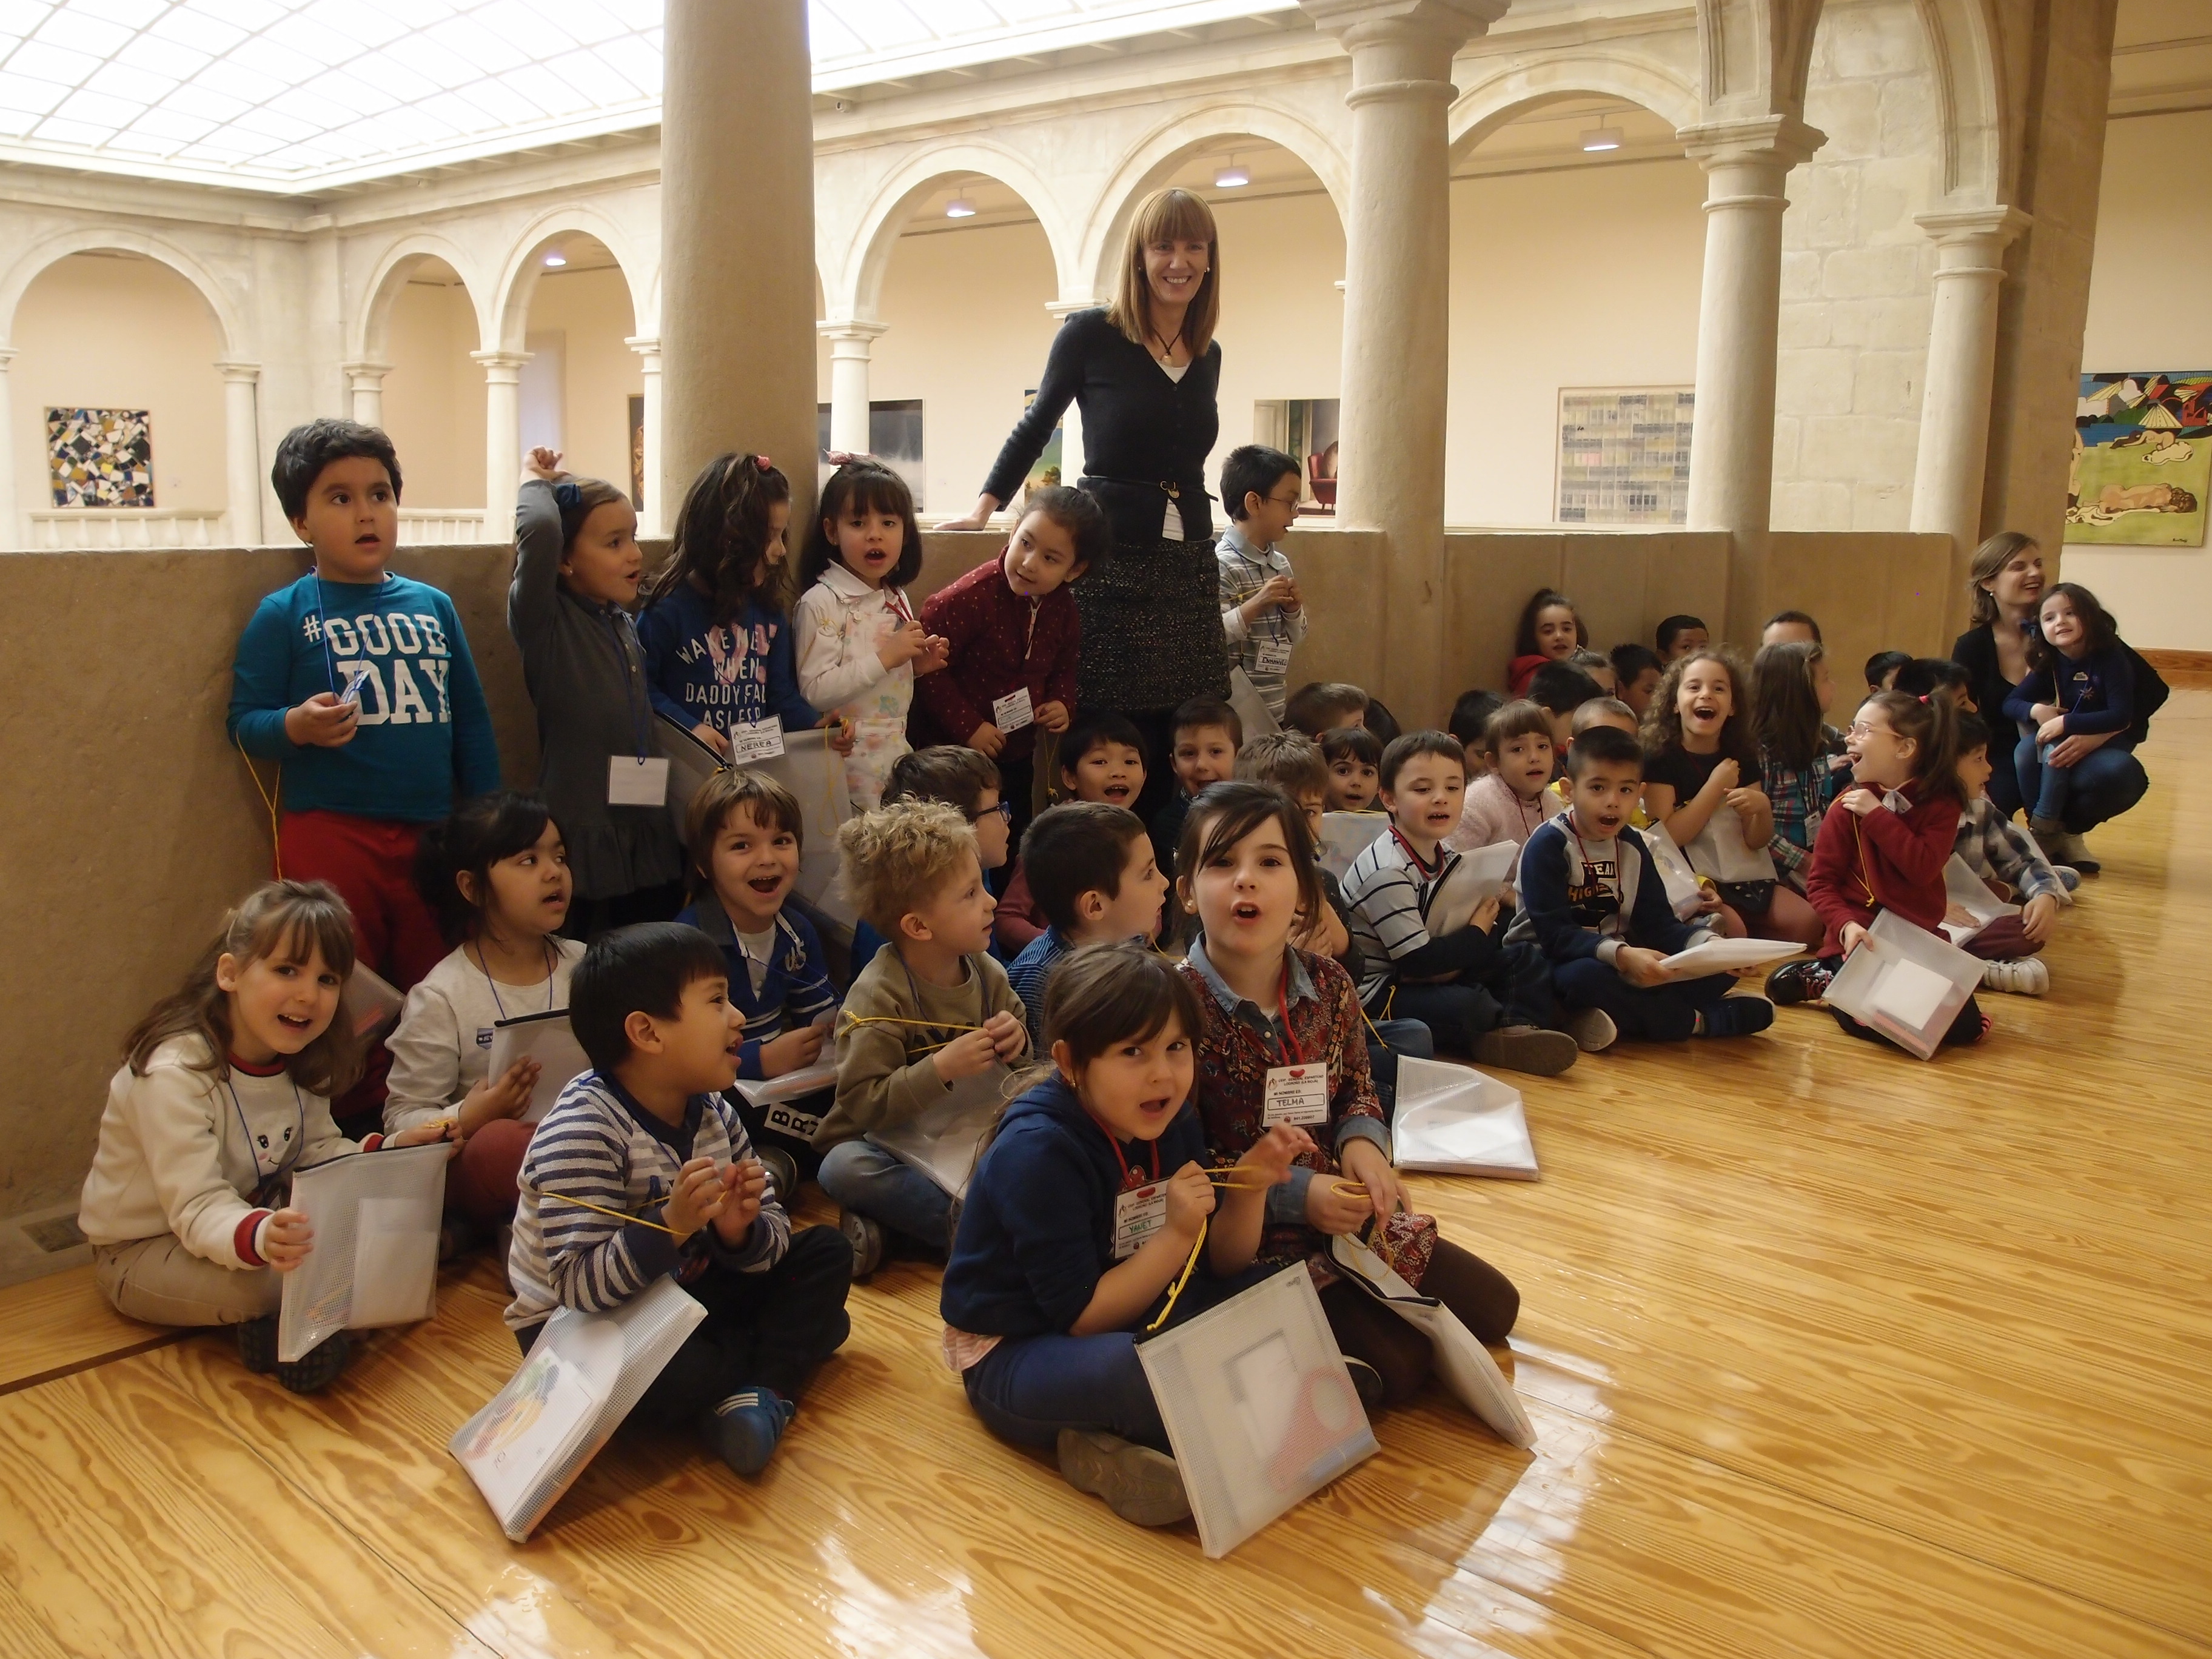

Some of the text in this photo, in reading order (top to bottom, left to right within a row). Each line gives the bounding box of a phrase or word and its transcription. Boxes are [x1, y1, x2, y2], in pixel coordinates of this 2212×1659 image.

[675, 628, 730, 665] WAKE
[712, 657, 760, 681] WHEN
[337, 659, 449, 725] DAY
[685, 682, 740, 705] DADDY
[741, 740, 772, 752] NEREA
[1276, 1098, 1305, 1107] TELMA
[1129, 1219, 1152, 1233] YANET
